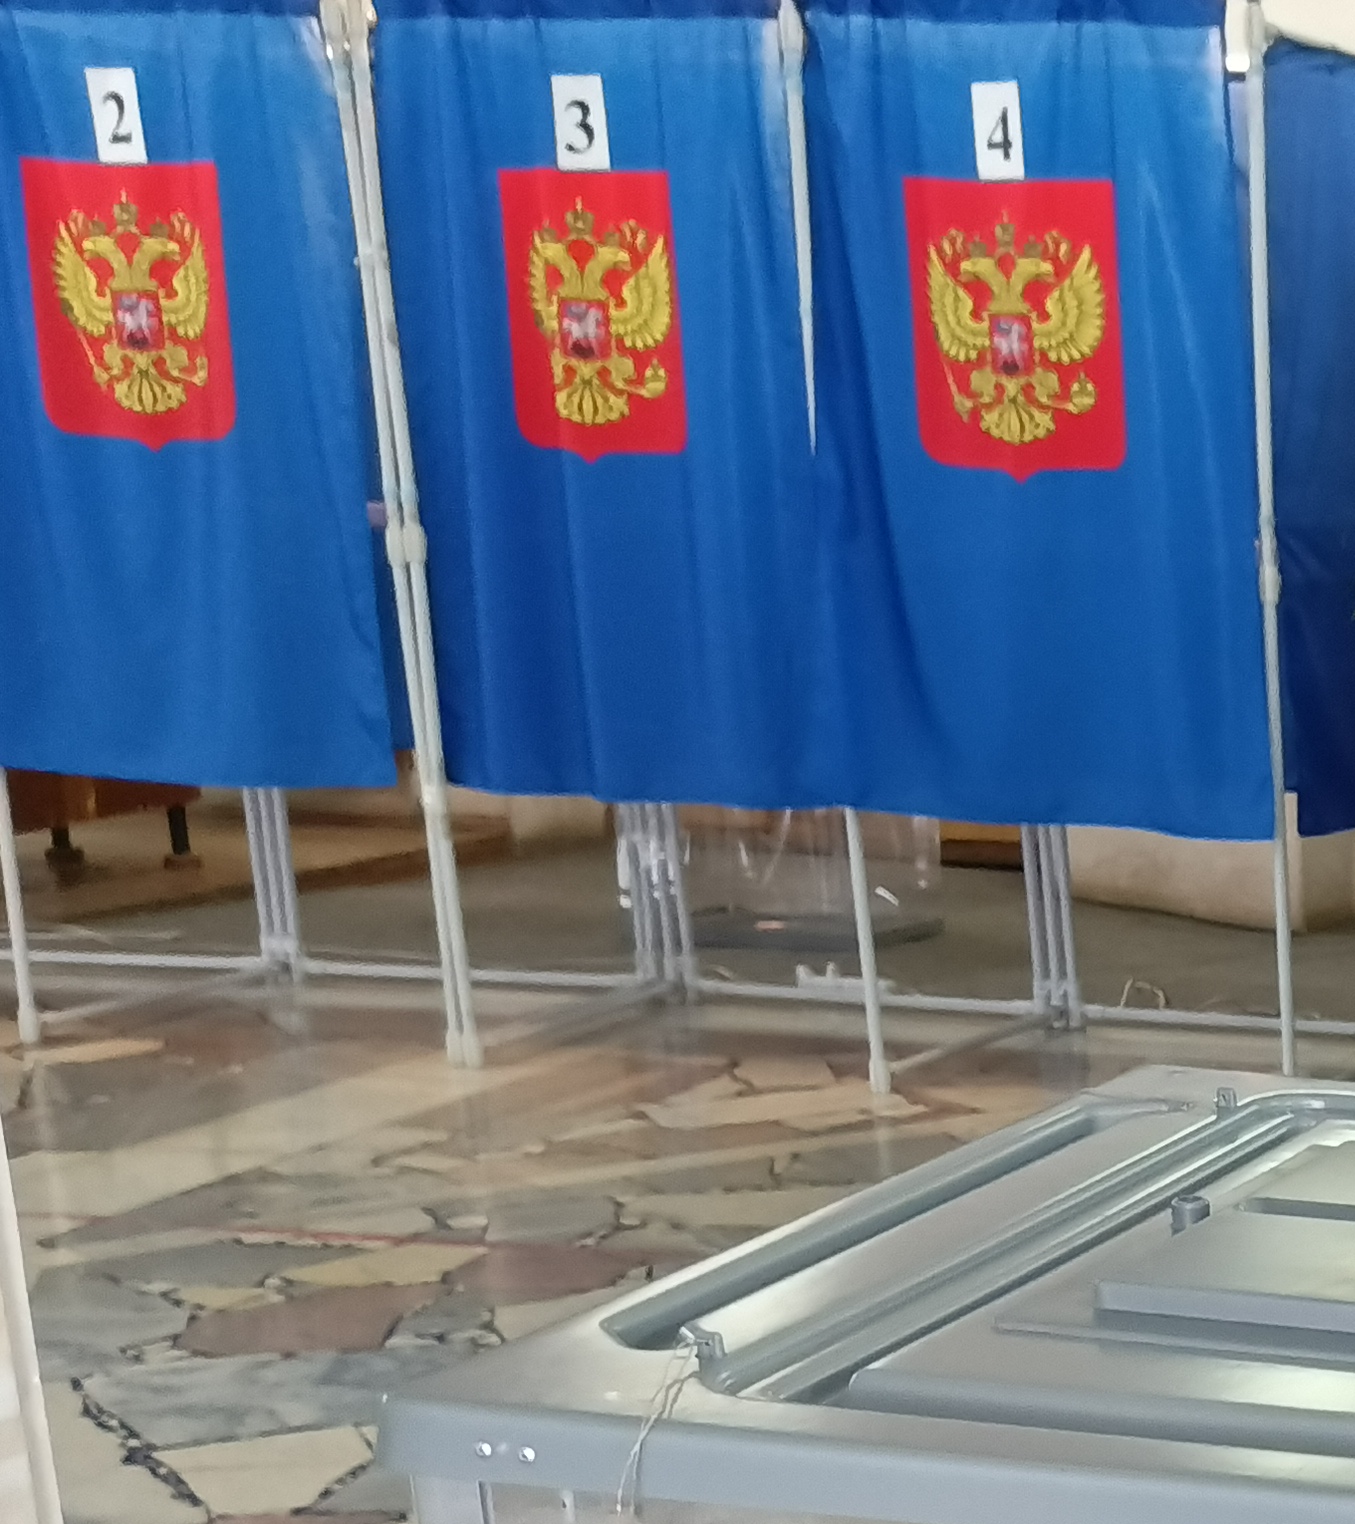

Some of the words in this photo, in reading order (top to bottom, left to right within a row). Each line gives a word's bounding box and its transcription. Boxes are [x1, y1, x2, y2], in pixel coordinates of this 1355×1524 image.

[102, 90, 132, 144] 2
[564, 100, 595, 154] 3
[986, 106, 1013, 160] 4
